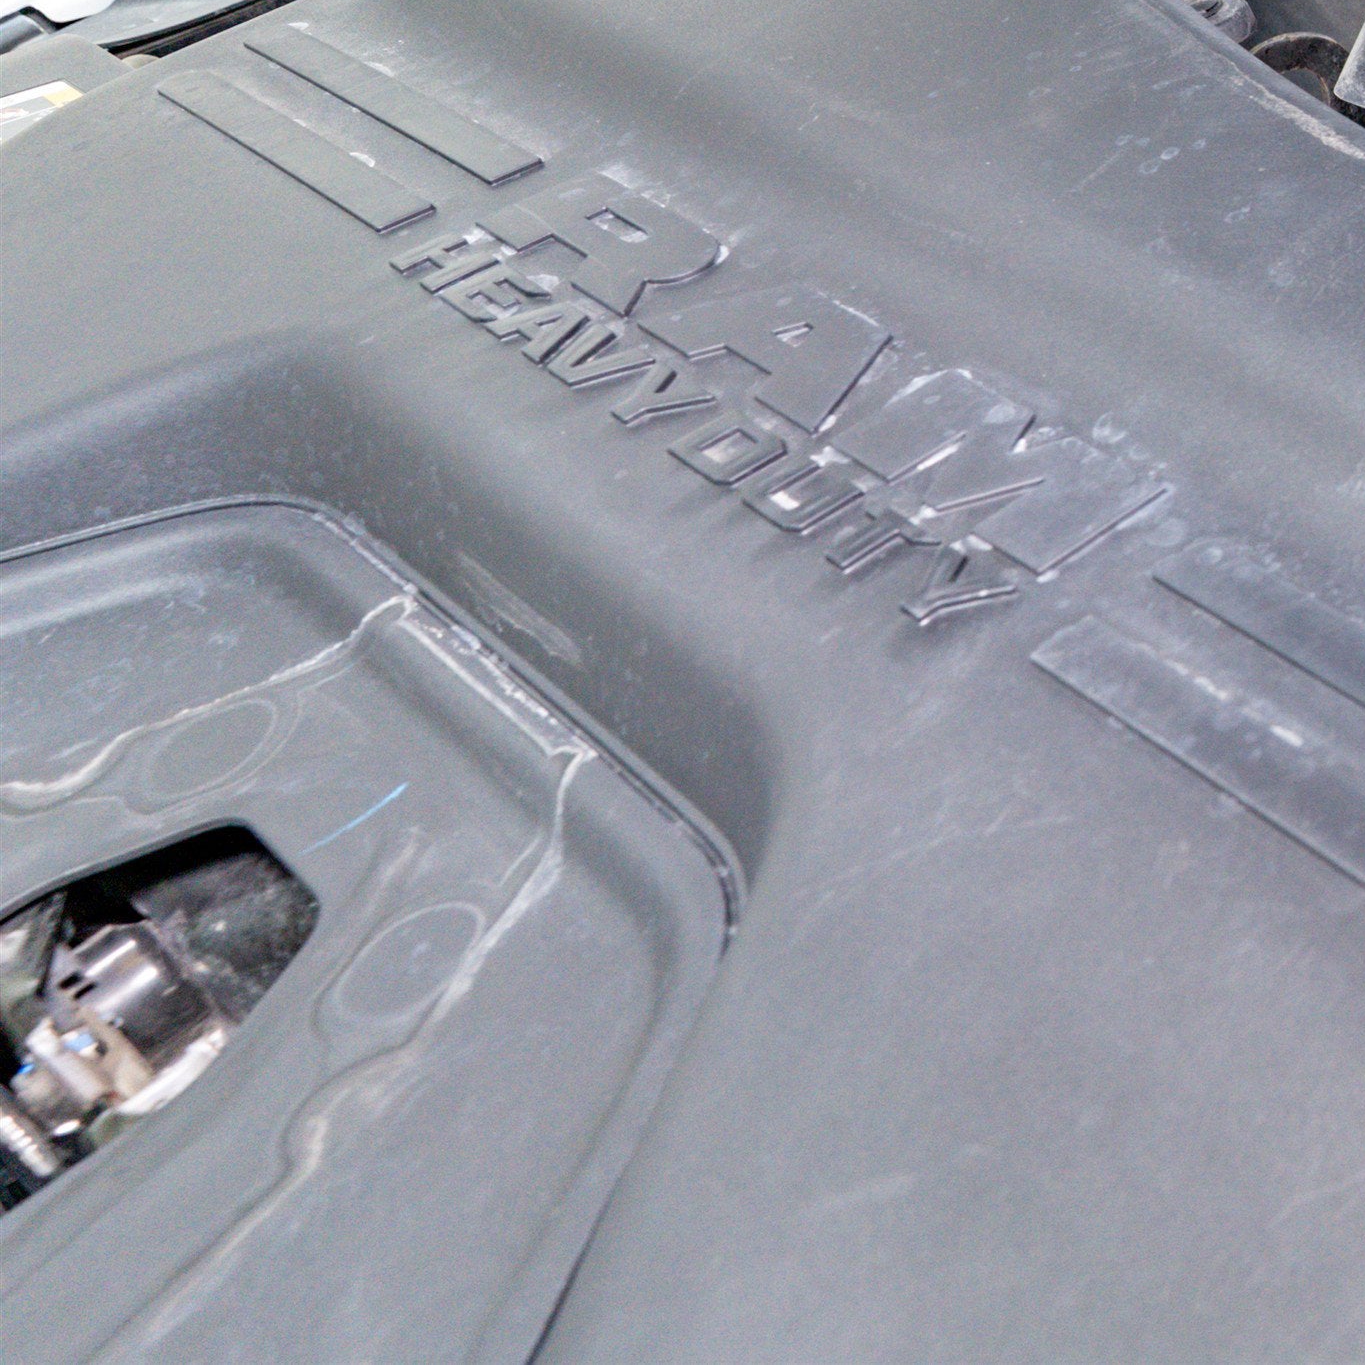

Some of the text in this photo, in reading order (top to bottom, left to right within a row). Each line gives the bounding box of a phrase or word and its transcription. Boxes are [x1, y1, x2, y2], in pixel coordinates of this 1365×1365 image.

[389, 227, 1020, 626] HEAVY DUTY
[473, 167, 1176, 577] RAM
